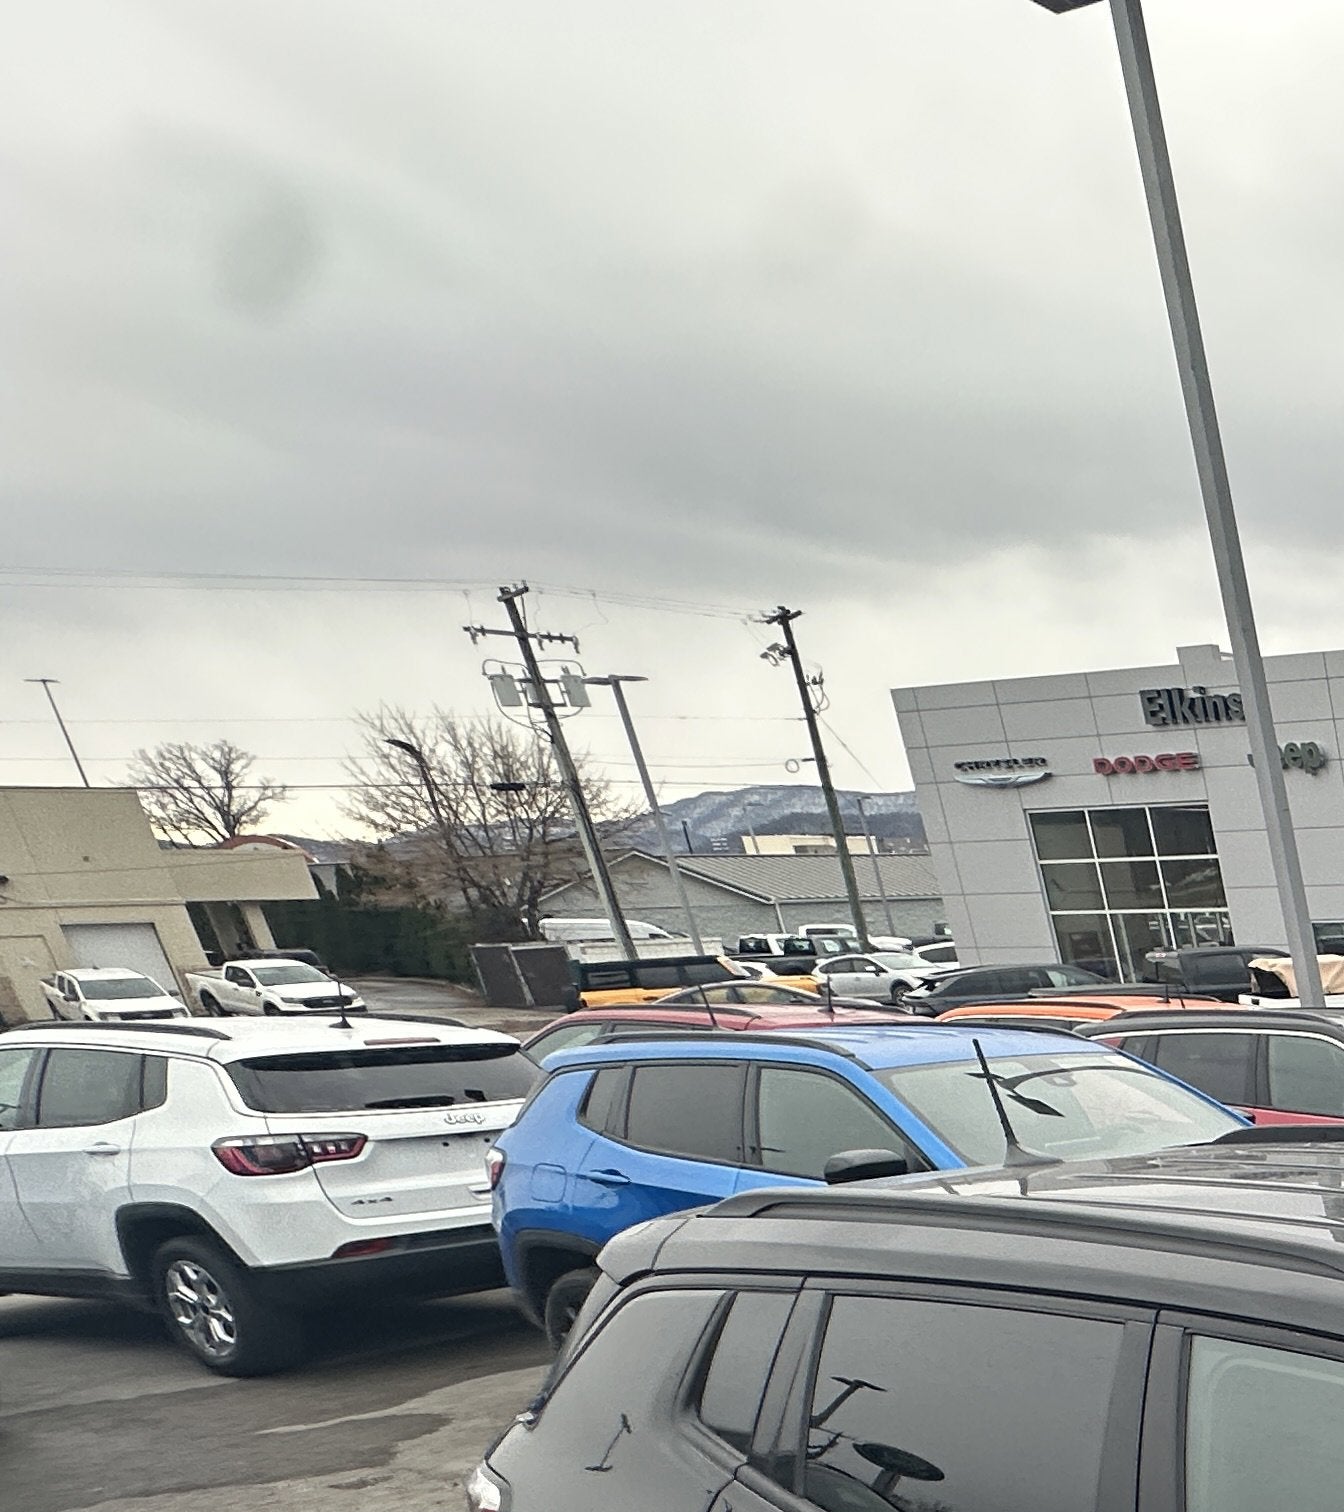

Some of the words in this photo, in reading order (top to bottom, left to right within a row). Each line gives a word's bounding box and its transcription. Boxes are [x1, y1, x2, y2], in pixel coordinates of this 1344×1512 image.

[1139, 686, 1246, 726] Elkins
[1093, 752, 1200, 776] DODGE
[1247, 742, 1326, 776] ep
[443, 1113, 485, 1125] Jeep
